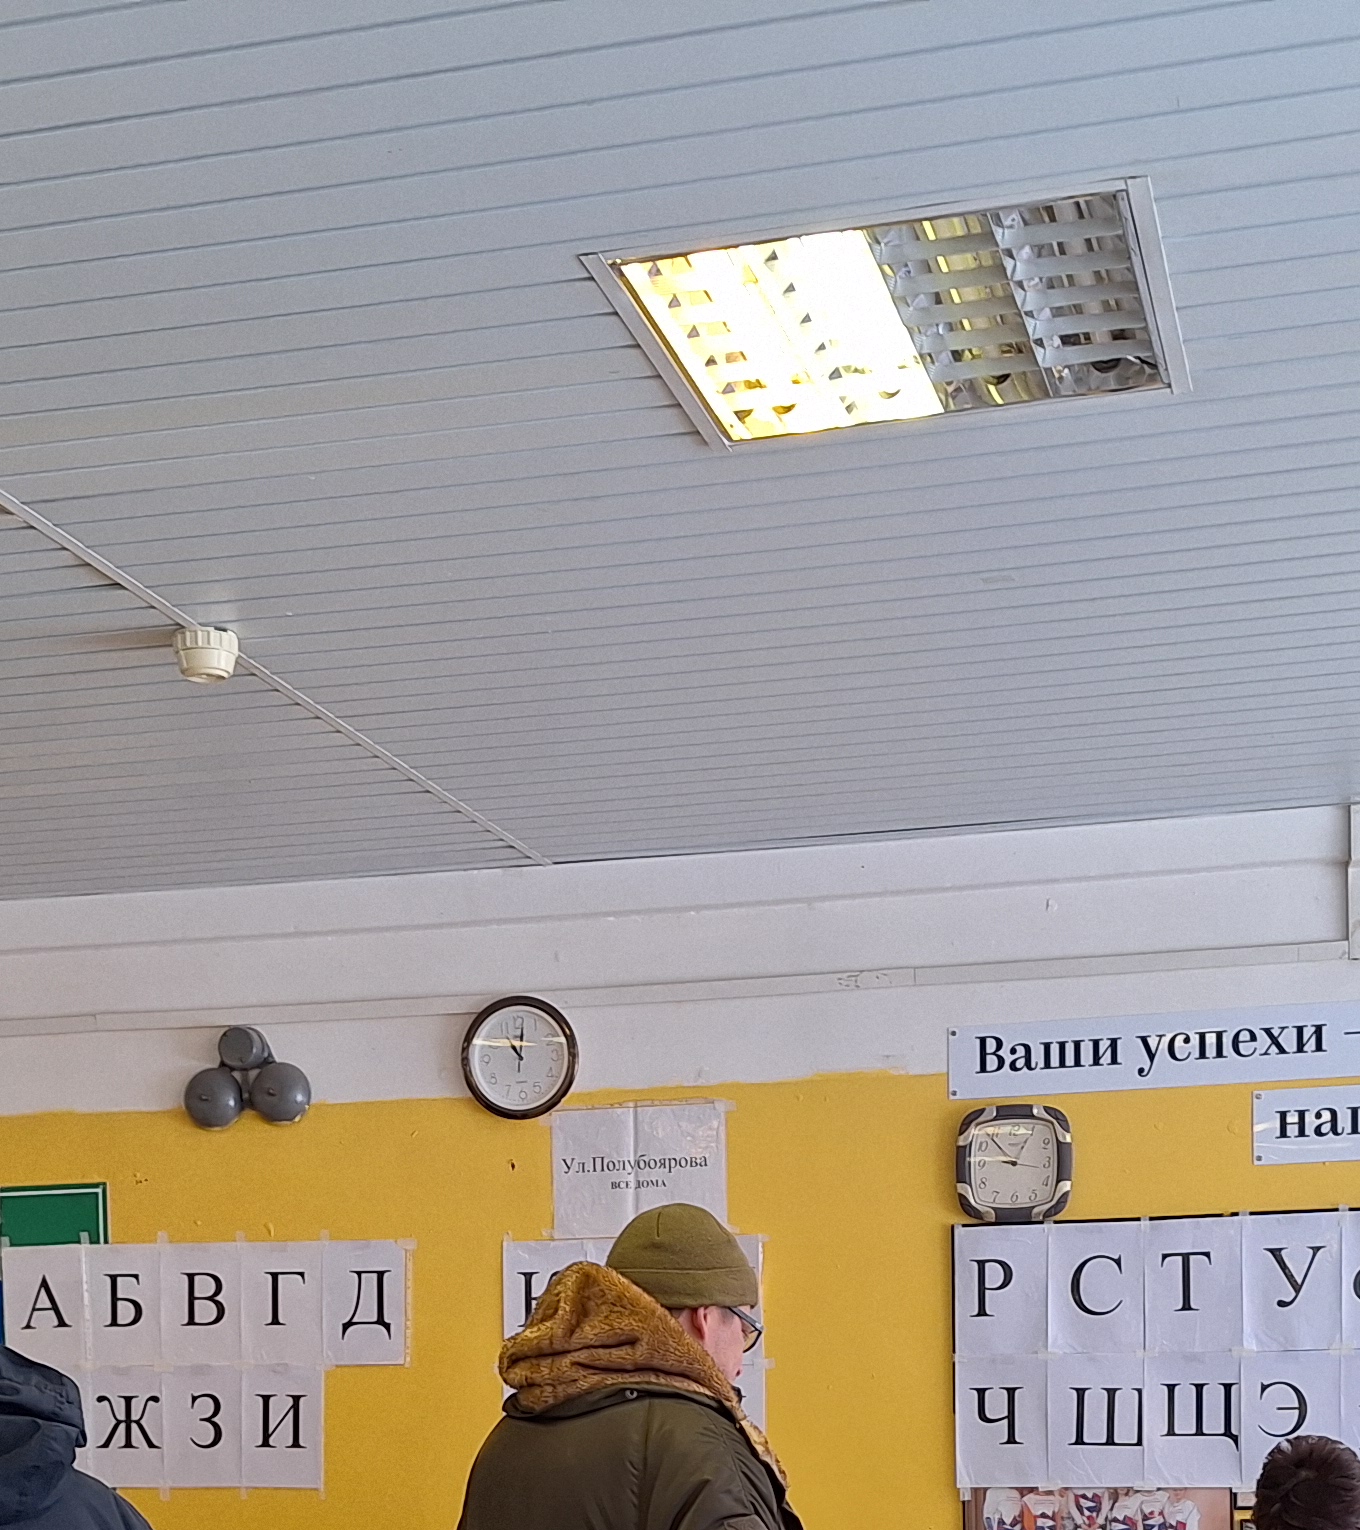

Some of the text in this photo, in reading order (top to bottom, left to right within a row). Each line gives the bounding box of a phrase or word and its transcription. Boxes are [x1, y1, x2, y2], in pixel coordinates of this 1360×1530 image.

[974, 1034, 1122, 1074] Ваши
[1135, 1023, 1328, 1077] успехи
[561, 1154, 709, 1176] Ул.Полубоярова
[610, 1179, 667, 1191] ВСЕ ДОМА
[21, 1270, 392, 1341] А Б В Г Д
[969, 1258, 1014, 1318] Р
[1070, 1254, 1124, 1316] С
[1160, 1251, 1213, 1312] Т
[1263, 1245, 1327, 1308] У
[96, 1393, 308, 1449] Ж З И
[969, 1386, 1025, 1446] Ч
[1067, 1387, 1143, 1447] Ш
[1160, 1382, 1239, 1453] Щ
[1258, 1381, 1308, 1438] Э
